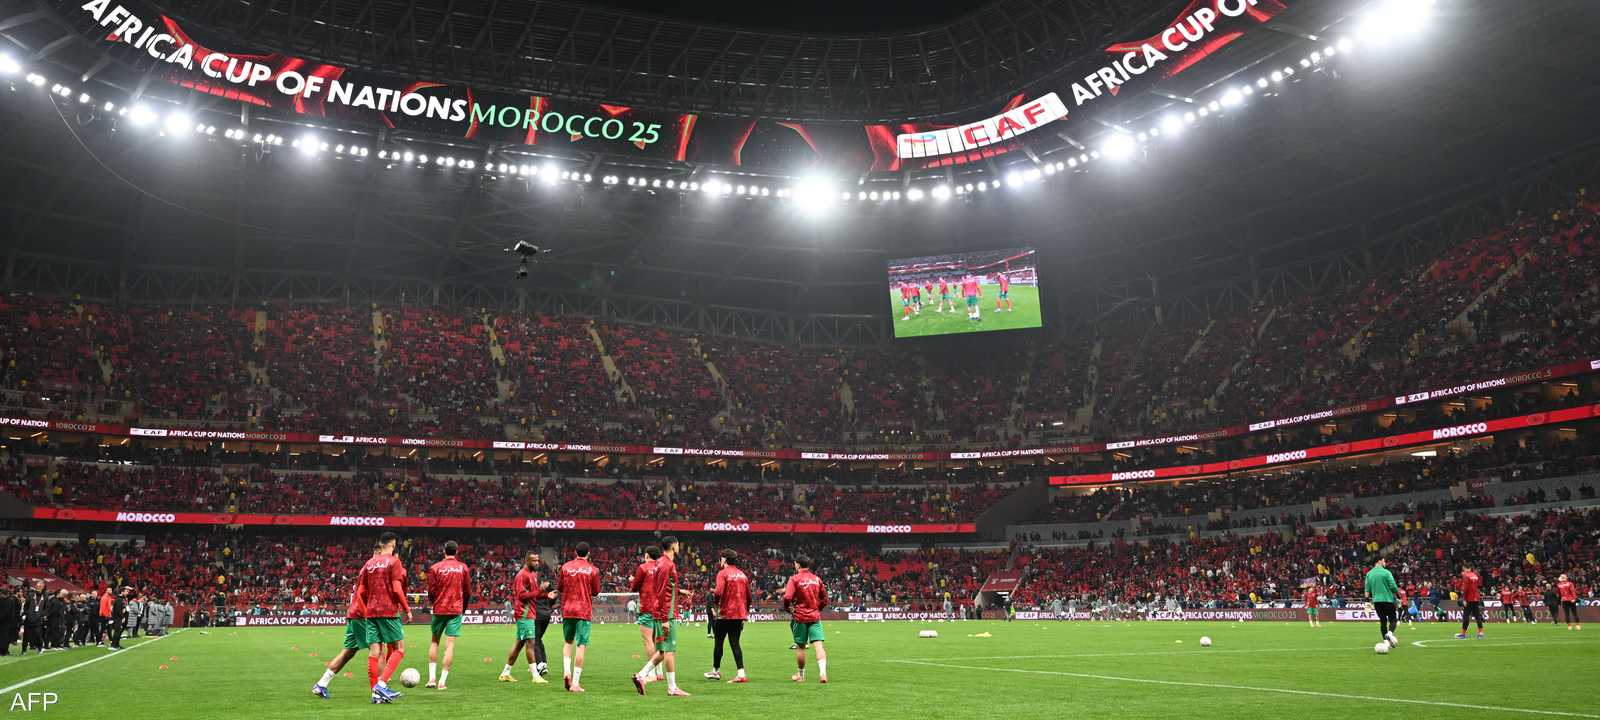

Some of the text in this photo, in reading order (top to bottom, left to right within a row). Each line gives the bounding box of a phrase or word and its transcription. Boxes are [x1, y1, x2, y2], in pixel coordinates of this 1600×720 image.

[81, 0, 661, 145] AFRICA CUP OF NATIONS MOROCCO 25
[963, 0, 1258, 145] CAF AFRICA CUP O
[1430, 388, 1453, 399] AFRICA
[1453, 384, 1467, 393] CUP
[1467, 382, 1476, 391] OF
[1476, 377, 1505, 389] NATIONS
[10, 417, 21, 425] OF
[21, 418, 48, 427] NATION
[1276, 418, 1293, 426] AFRICA
[1293, 415, 1303, 423] CUP
[1310, 409, 1333, 419] NATIONS
[1432, 422, 1488, 440] MOROCCO
[1136, 439, 1154, 447] AFRICA
[1175, 434, 1198, 442] NATIONS
[684, 448, 702, 456] AFRICA
[1020, 448, 1044, 456] NATIONS
[1266, 450, 1307, 464] MOROCCO
[1111, 470, 1155, 481] MOROCCO
[116, 512, 175, 523] MOROCCO
[330, 516, 385, 526] MOROCCO
[525, 519, 576, 529] MOROCCO
[866, 525, 912, 533] MOROCCO
[1288, 610, 1297, 618] 25
[1421, 611, 1433, 620] UP
[249, 617, 346, 625] AFRICA CUP OF NATIONS
